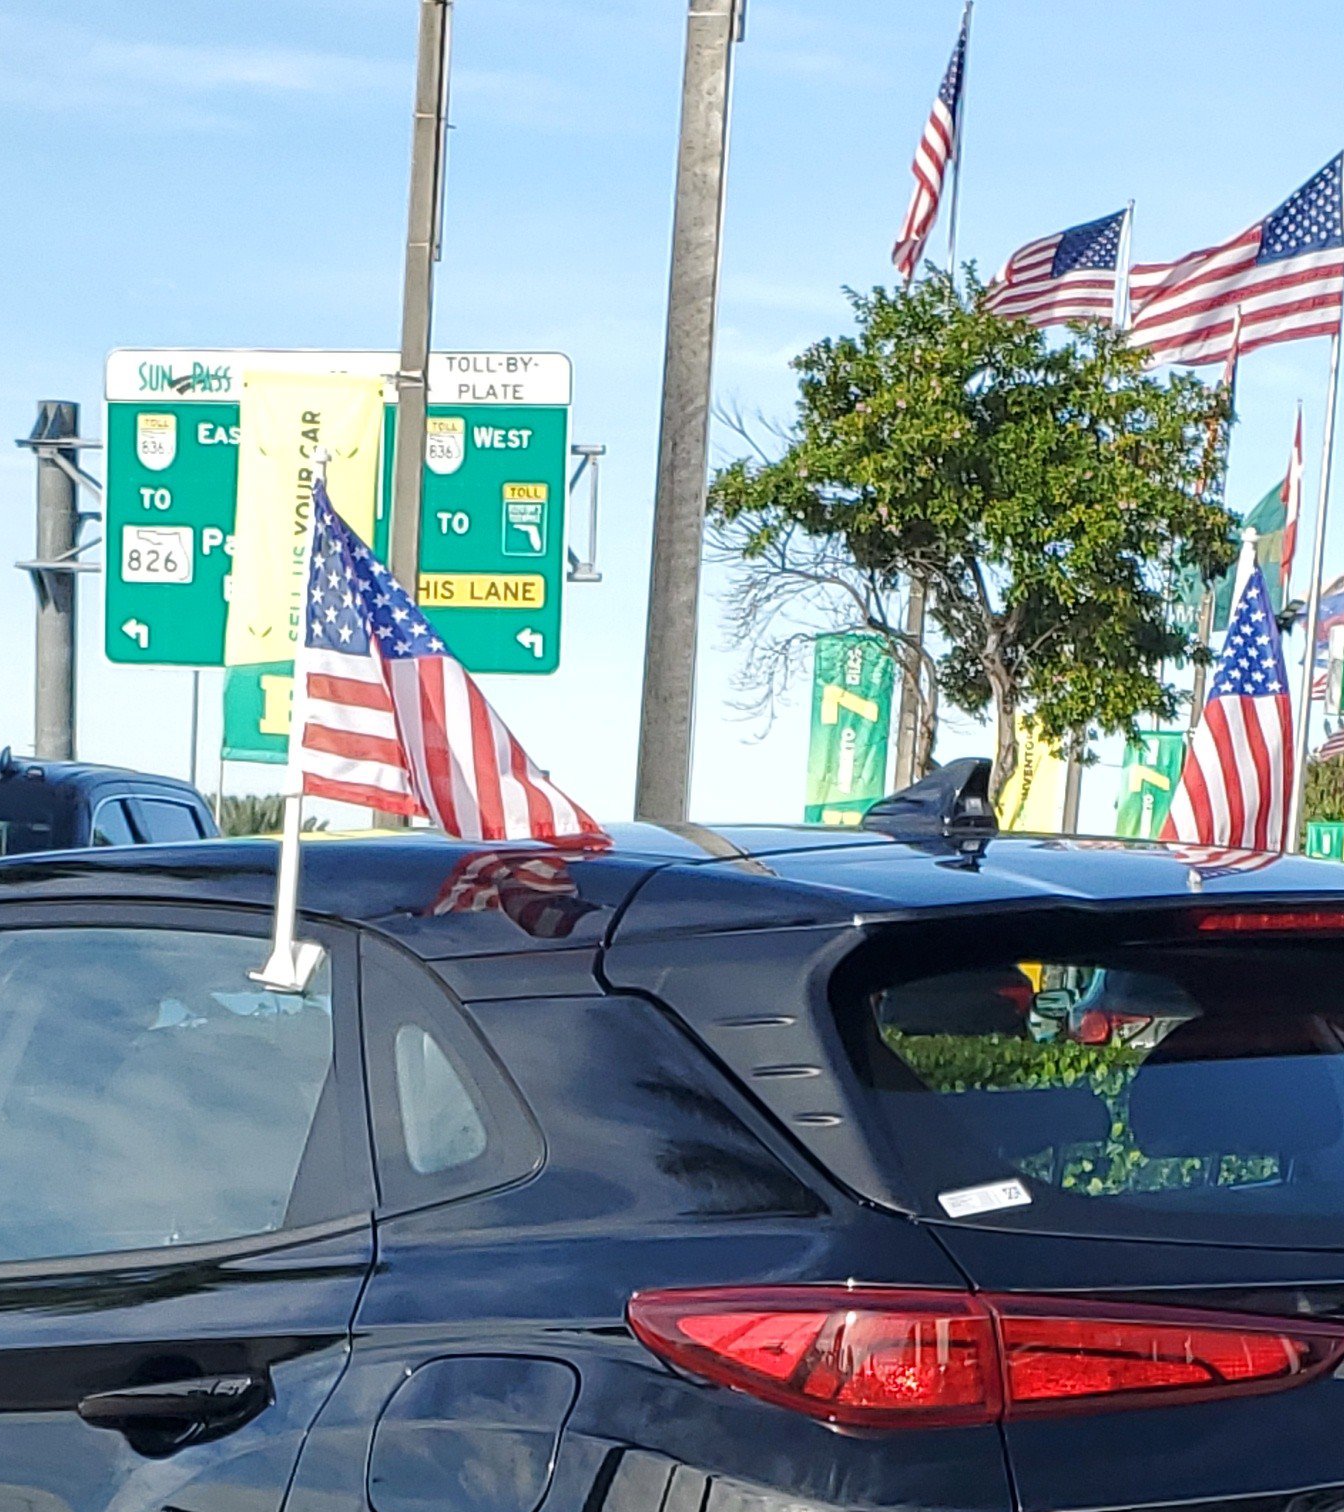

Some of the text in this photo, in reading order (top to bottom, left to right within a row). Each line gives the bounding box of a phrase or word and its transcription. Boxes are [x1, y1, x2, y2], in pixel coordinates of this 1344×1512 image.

[138, 361, 232, 393] SUN PASS
[458, 384, 524, 400] PLATE
[197, 422, 241, 445] EAS
[473, 426, 532, 449] WEST
[140, 487, 171, 510] TO
[510, 487, 541, 498] TOLL
[437, 511, 470, 534] TO
[127, 549, 178, 572] 826
[419, 580, 536, 601] HIS LANE
